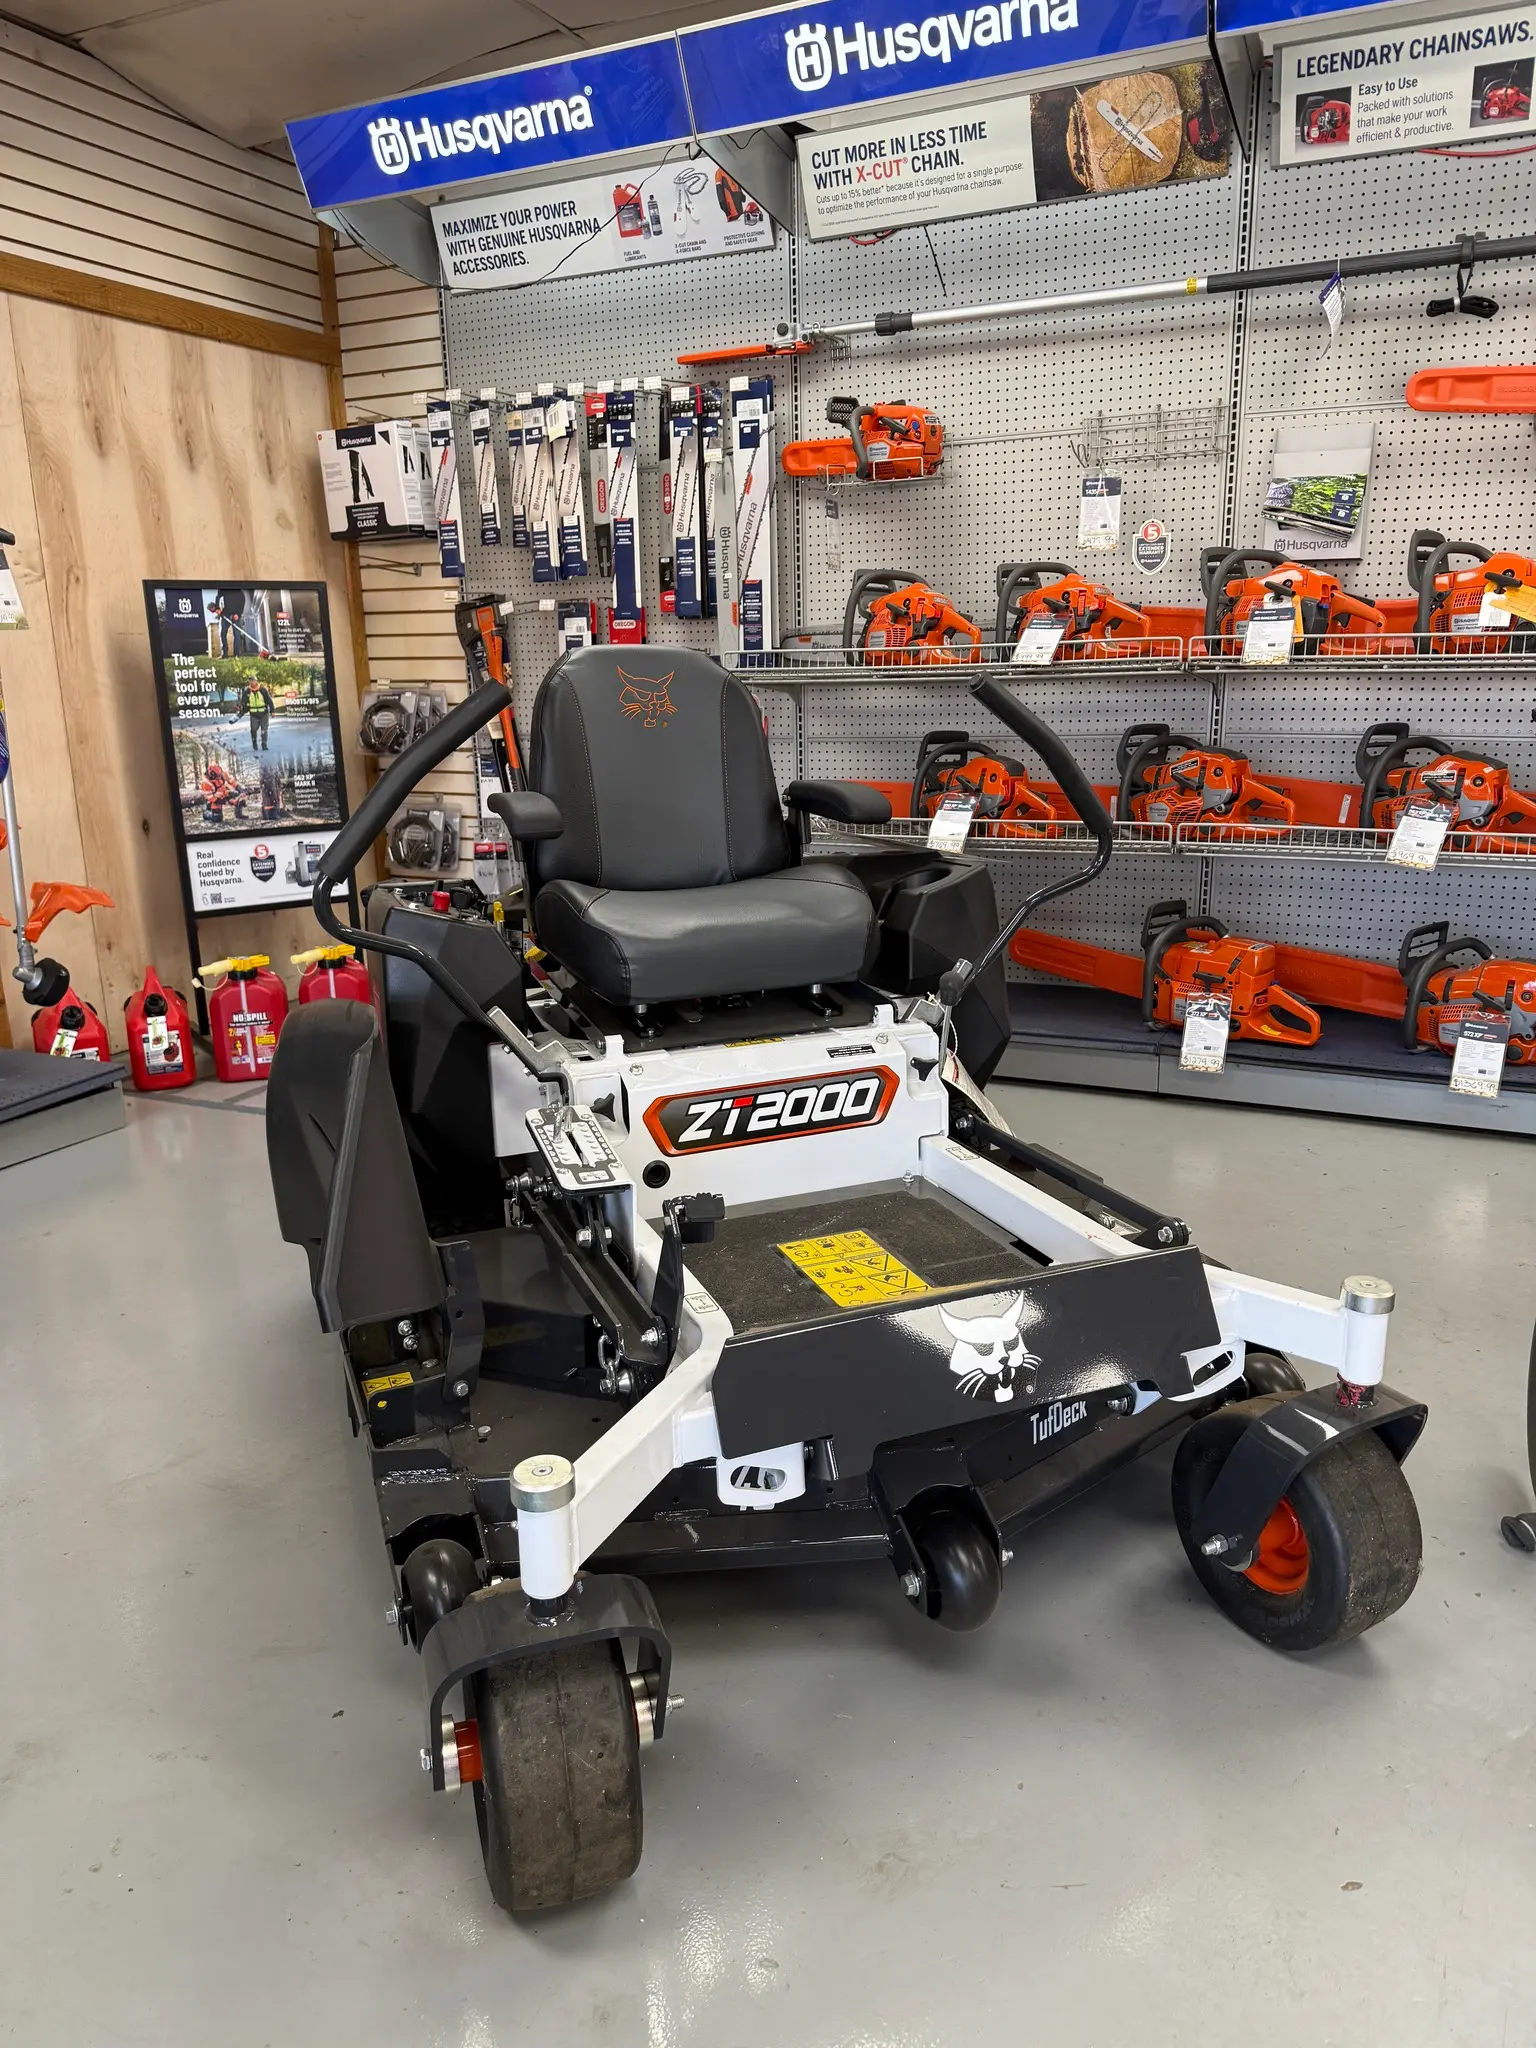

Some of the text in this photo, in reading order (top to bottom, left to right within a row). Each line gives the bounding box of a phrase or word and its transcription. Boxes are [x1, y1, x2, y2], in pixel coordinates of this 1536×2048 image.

[833, 0, 1080, 75] Husqvarna
[1296, 19, 1534, 79] LEGENDARY CHAINSAWS.
[1358, 76, 1418, 97] Easy to Use
[1357, 89, 1454, 113] Packed with solutions
[1356, 105, 1448, 128] that make your work
[1356, 121, 1454, 144] efficient & productive.
[811, 121, 987, 169] CUT MORE IN LESS TIME
[813, 168, 852, 190] WITH
[911, 149, 964, 173] CHAIN.
[816, 194, 831, 204] Cuts
[831, 193, 840, 203] up
[840, 191, 848, 200] to
[848, 188, 861, 199] 15%
[886, 181, 913, 193] because
[914, 178, 925, 187] it's
[925, 173, 955, 186] designed
[956, 171, 966, 180] for
[972, 166, 993, 178] single
[818, 178, 1004, 215] to optimize the performance of your Husqvarna chainsaw.
[442, 200, 577, 238] MAXIMIZE YOUR POWER
[446, 217, 602, 257] WITH GENUINE HUSQVARNA
[723, 232, 746, 241] PROTECTIVE
[453, 250, 530, 276] ACCESSORIES.
[624, 253, 647, 262] LUBRICANTS
[613, 473, 625, 509] Husqvarna
[680, 472, 690, 521] Husqvarna
[356, 519, 378, 528] CLASSIC
[738, 501, 758, 568] Husqvarna
[1147, 526, 1159, 540] 5
[1286, 539, 1348, 551] Husqvarna
[171, 653, 195, 666] The
[174, 666, 217, 681] perfect
[175, 680, 217, 693] tool for
[177, 694, 211, 707] every
[178, 706, 224, 719] season.
[196, 850, 214, 859] Real
[198, 858, 241, 868] confidence
[257, 847, 267, 858] 5
[198, 867, 235, 878] fueled by
[199, 877, 244, 887] Husqvarna.
[678, 1077, 881, 1143] ZT2000
[1030, 1401, 1087, 1445] TufDeck
